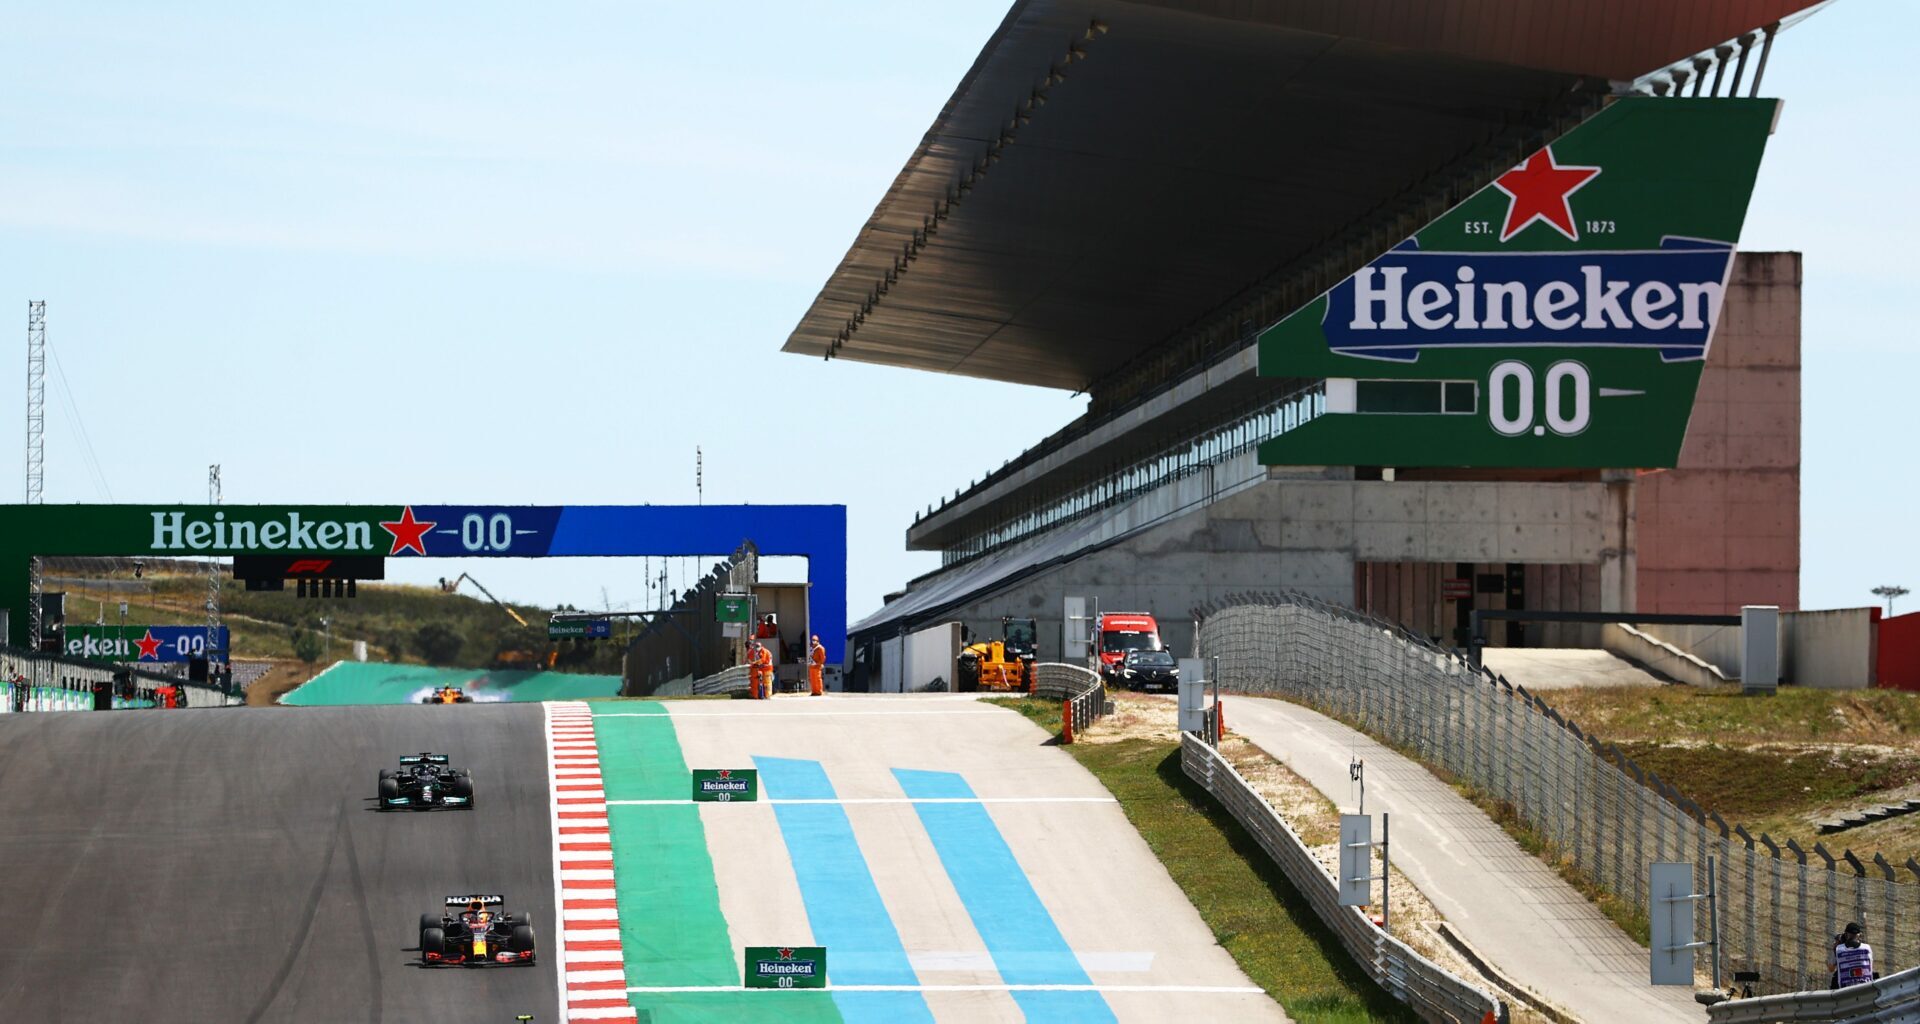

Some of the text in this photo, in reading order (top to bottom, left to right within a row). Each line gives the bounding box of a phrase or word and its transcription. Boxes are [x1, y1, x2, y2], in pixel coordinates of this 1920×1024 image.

[1465, 220, 1616, 234] EST. 1873
[1349, 266, 1723, 330] Heineken
[1489, 361, 1591, 437] 0.0
[150, 511, 512, 551] Heineken 0.0
[65, 634, 130, 658] eken
[703, 780, 746, 790] Heineken
[760, 962, 812, 974] Heineken
